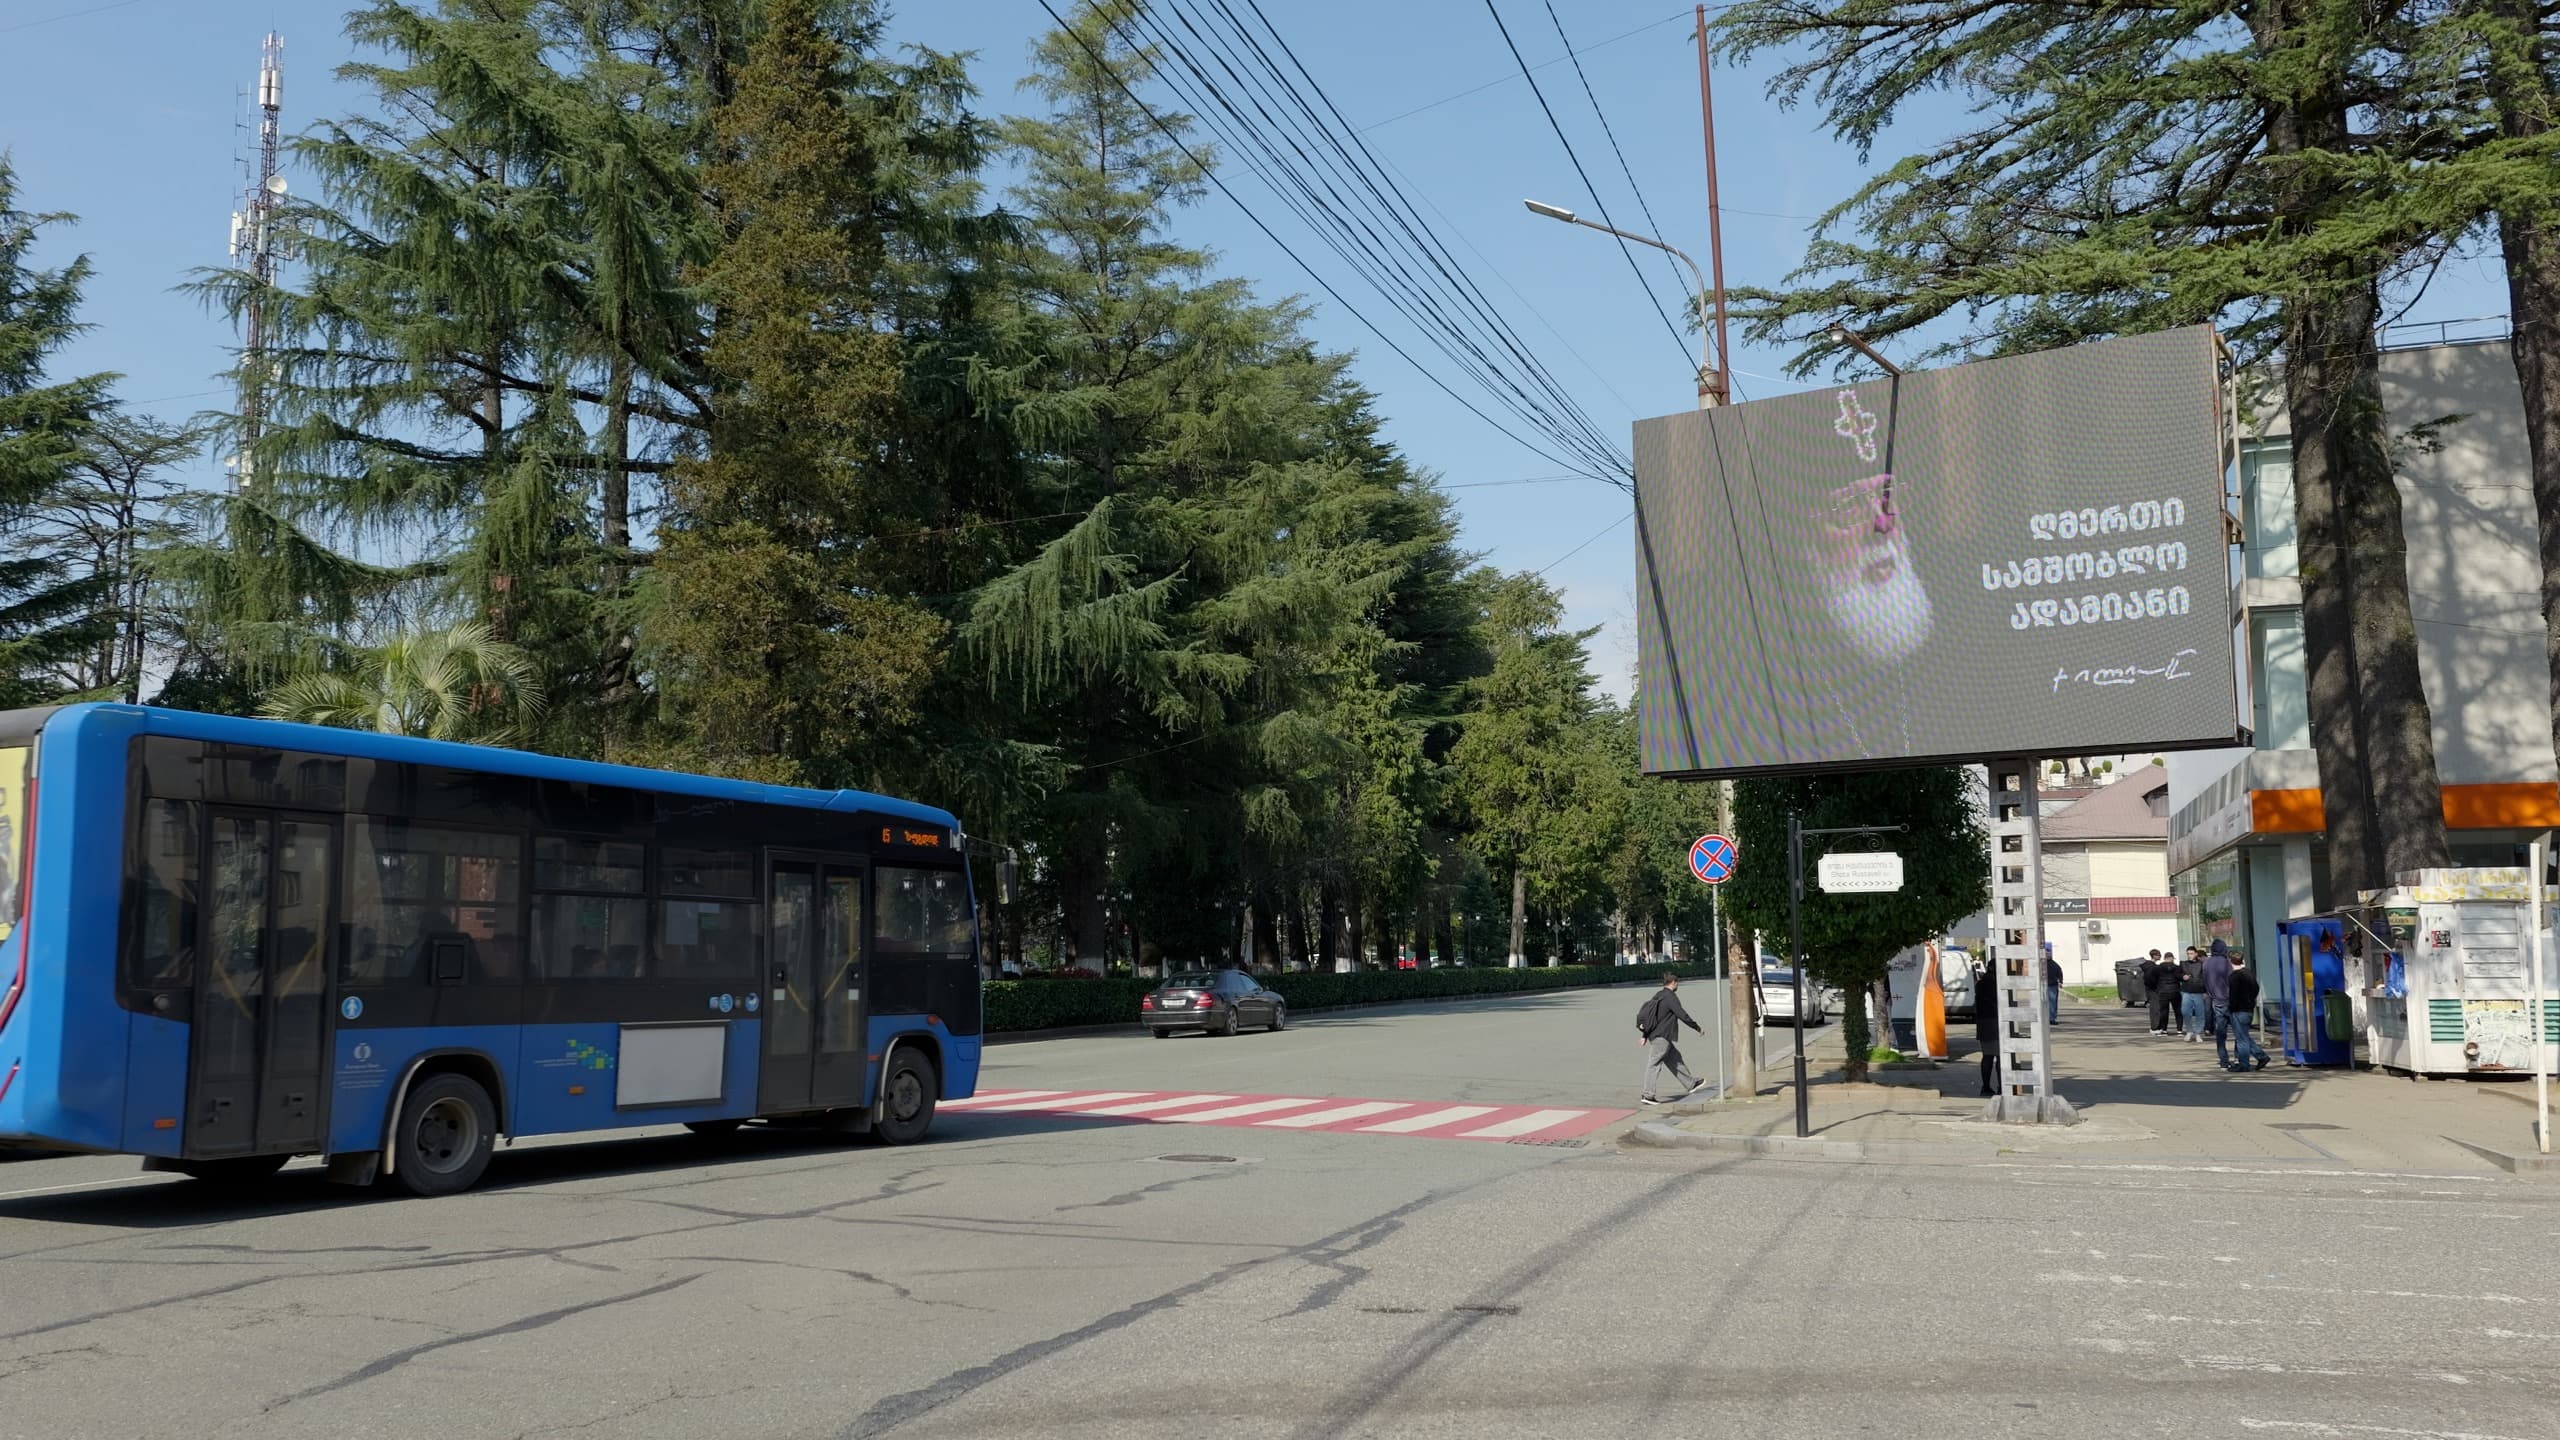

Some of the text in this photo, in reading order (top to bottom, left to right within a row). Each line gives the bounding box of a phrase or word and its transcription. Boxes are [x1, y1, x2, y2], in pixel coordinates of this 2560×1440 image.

[2030, 497, 2185, 540] ღმერთი
[1981, 541, 2188, 590] სამშობლო
[2010, 585, 2190, 631] ადამიანი
